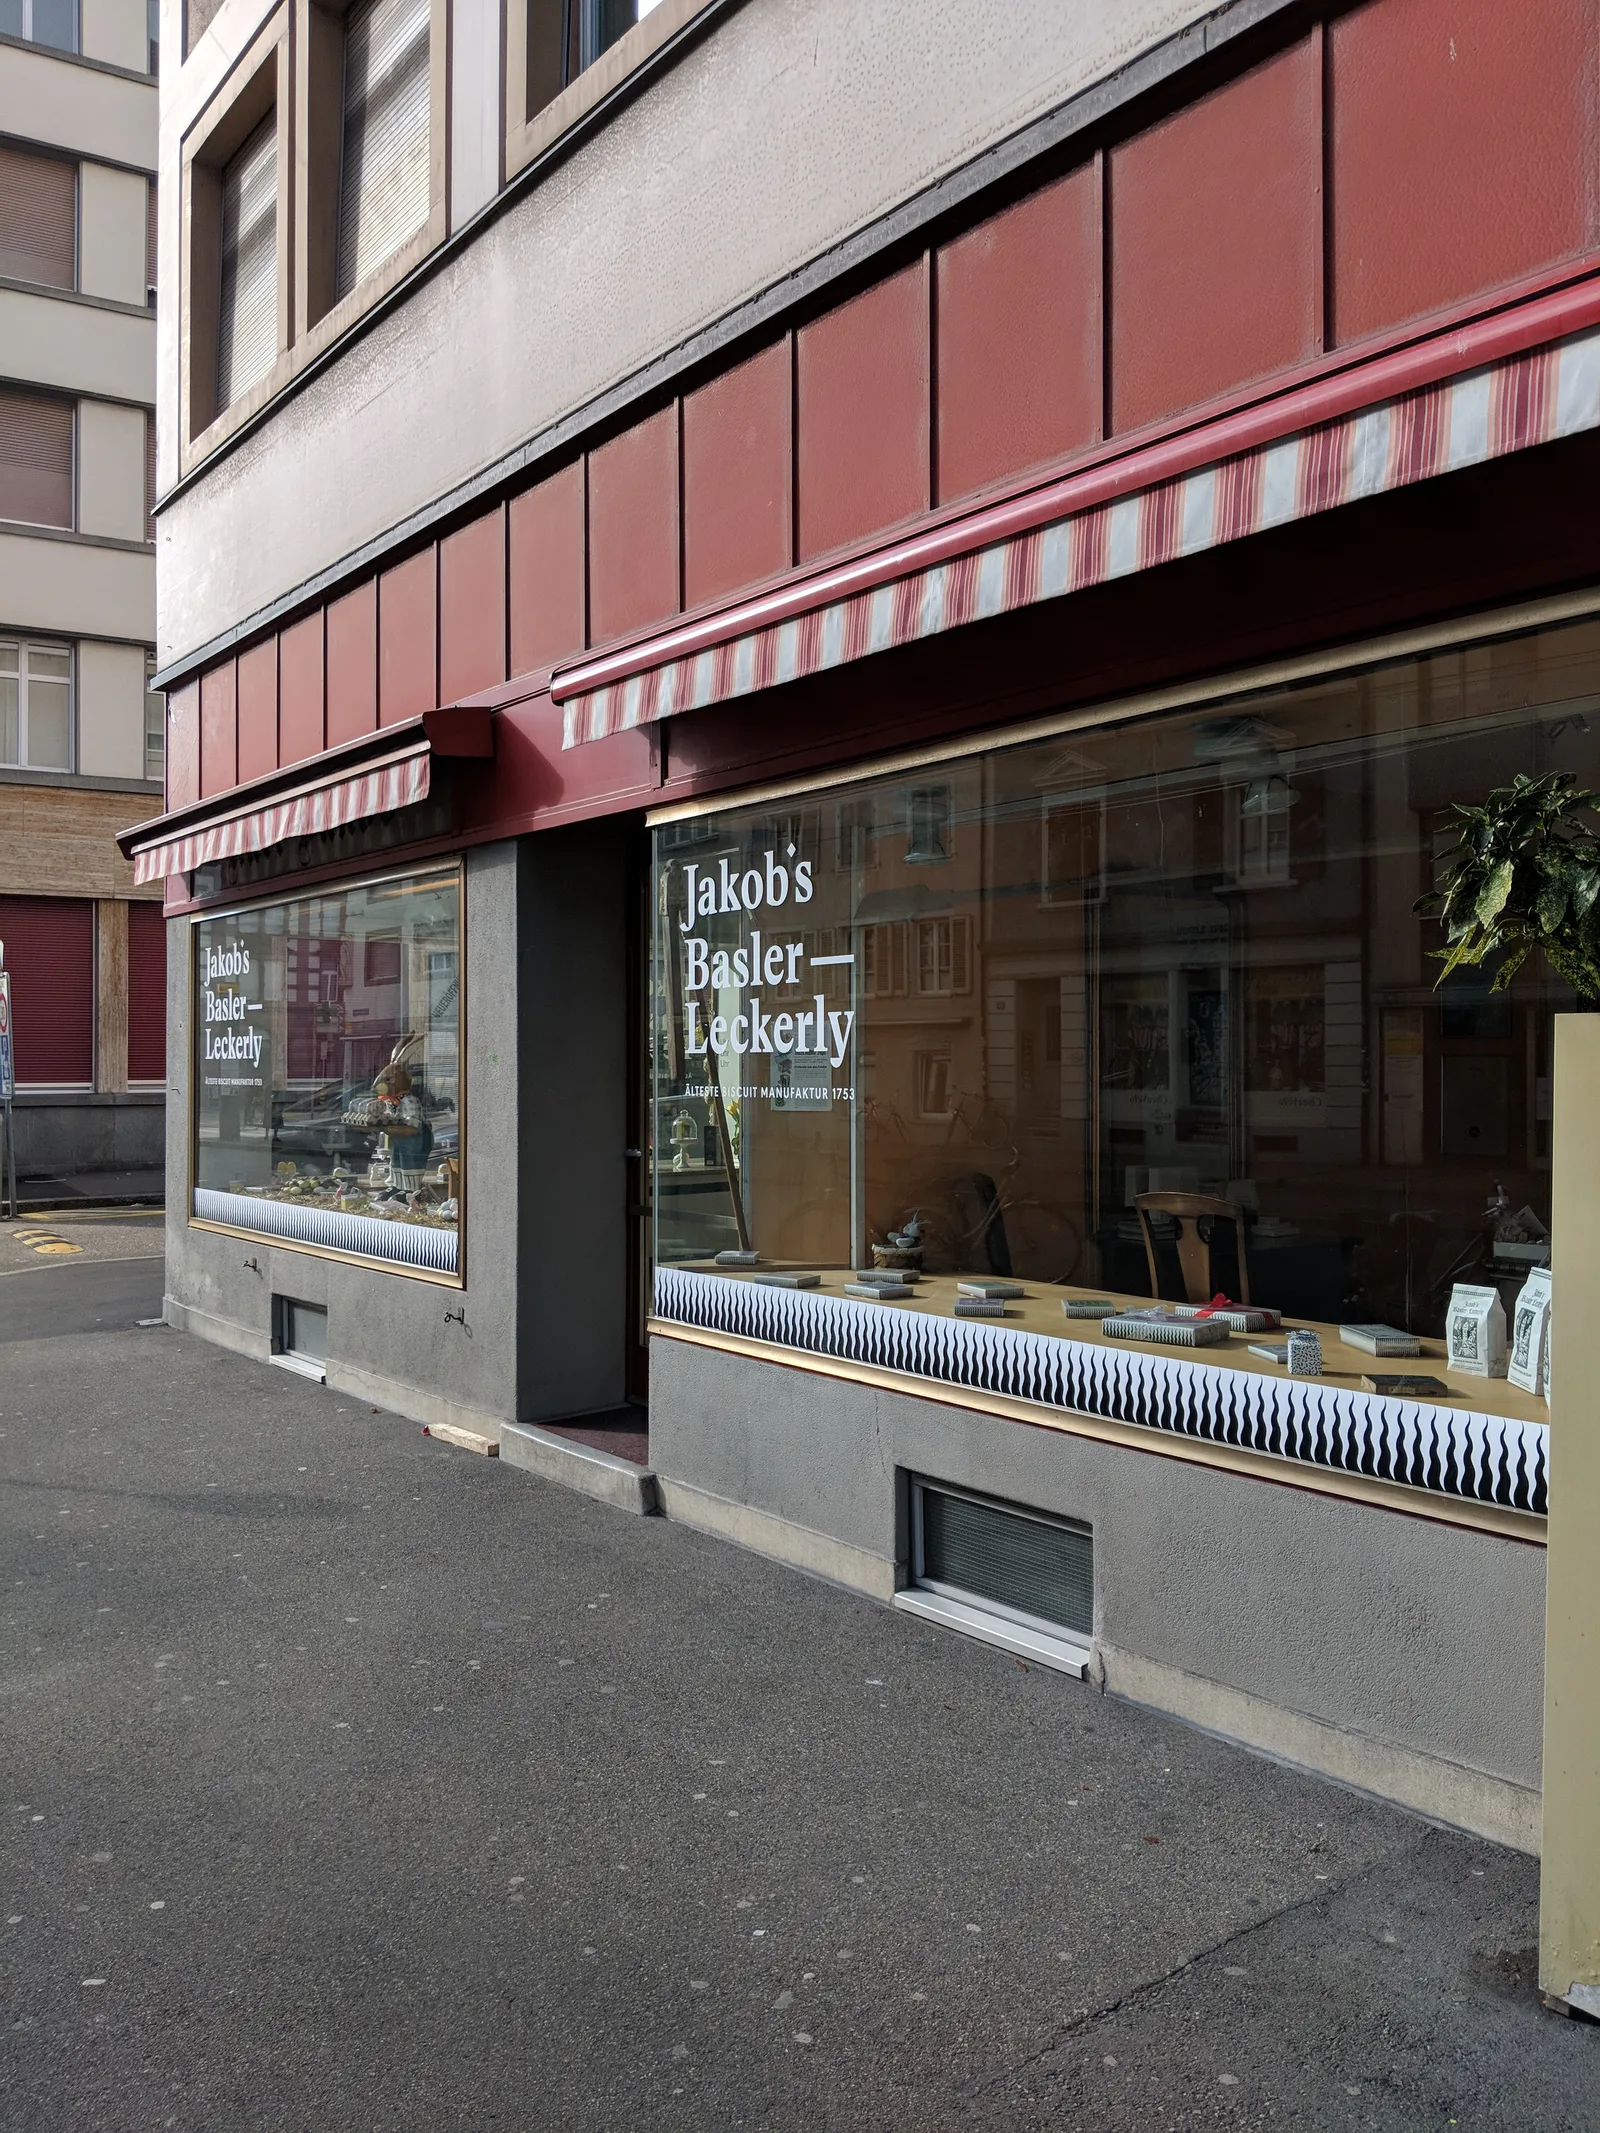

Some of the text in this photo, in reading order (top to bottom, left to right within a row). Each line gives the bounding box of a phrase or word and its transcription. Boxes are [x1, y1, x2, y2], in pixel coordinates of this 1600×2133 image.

[679, 842, 813, 932] Jakob's
[203, 939, 250, 987] Jakob's
[205, 1026, 263, 1068] Leckerly
[684, 994, 855, 1068] Leckerly
[685, 1083, 855, 1101] ÄLTESTE BISCUIT MANUFAKTUR 1753
